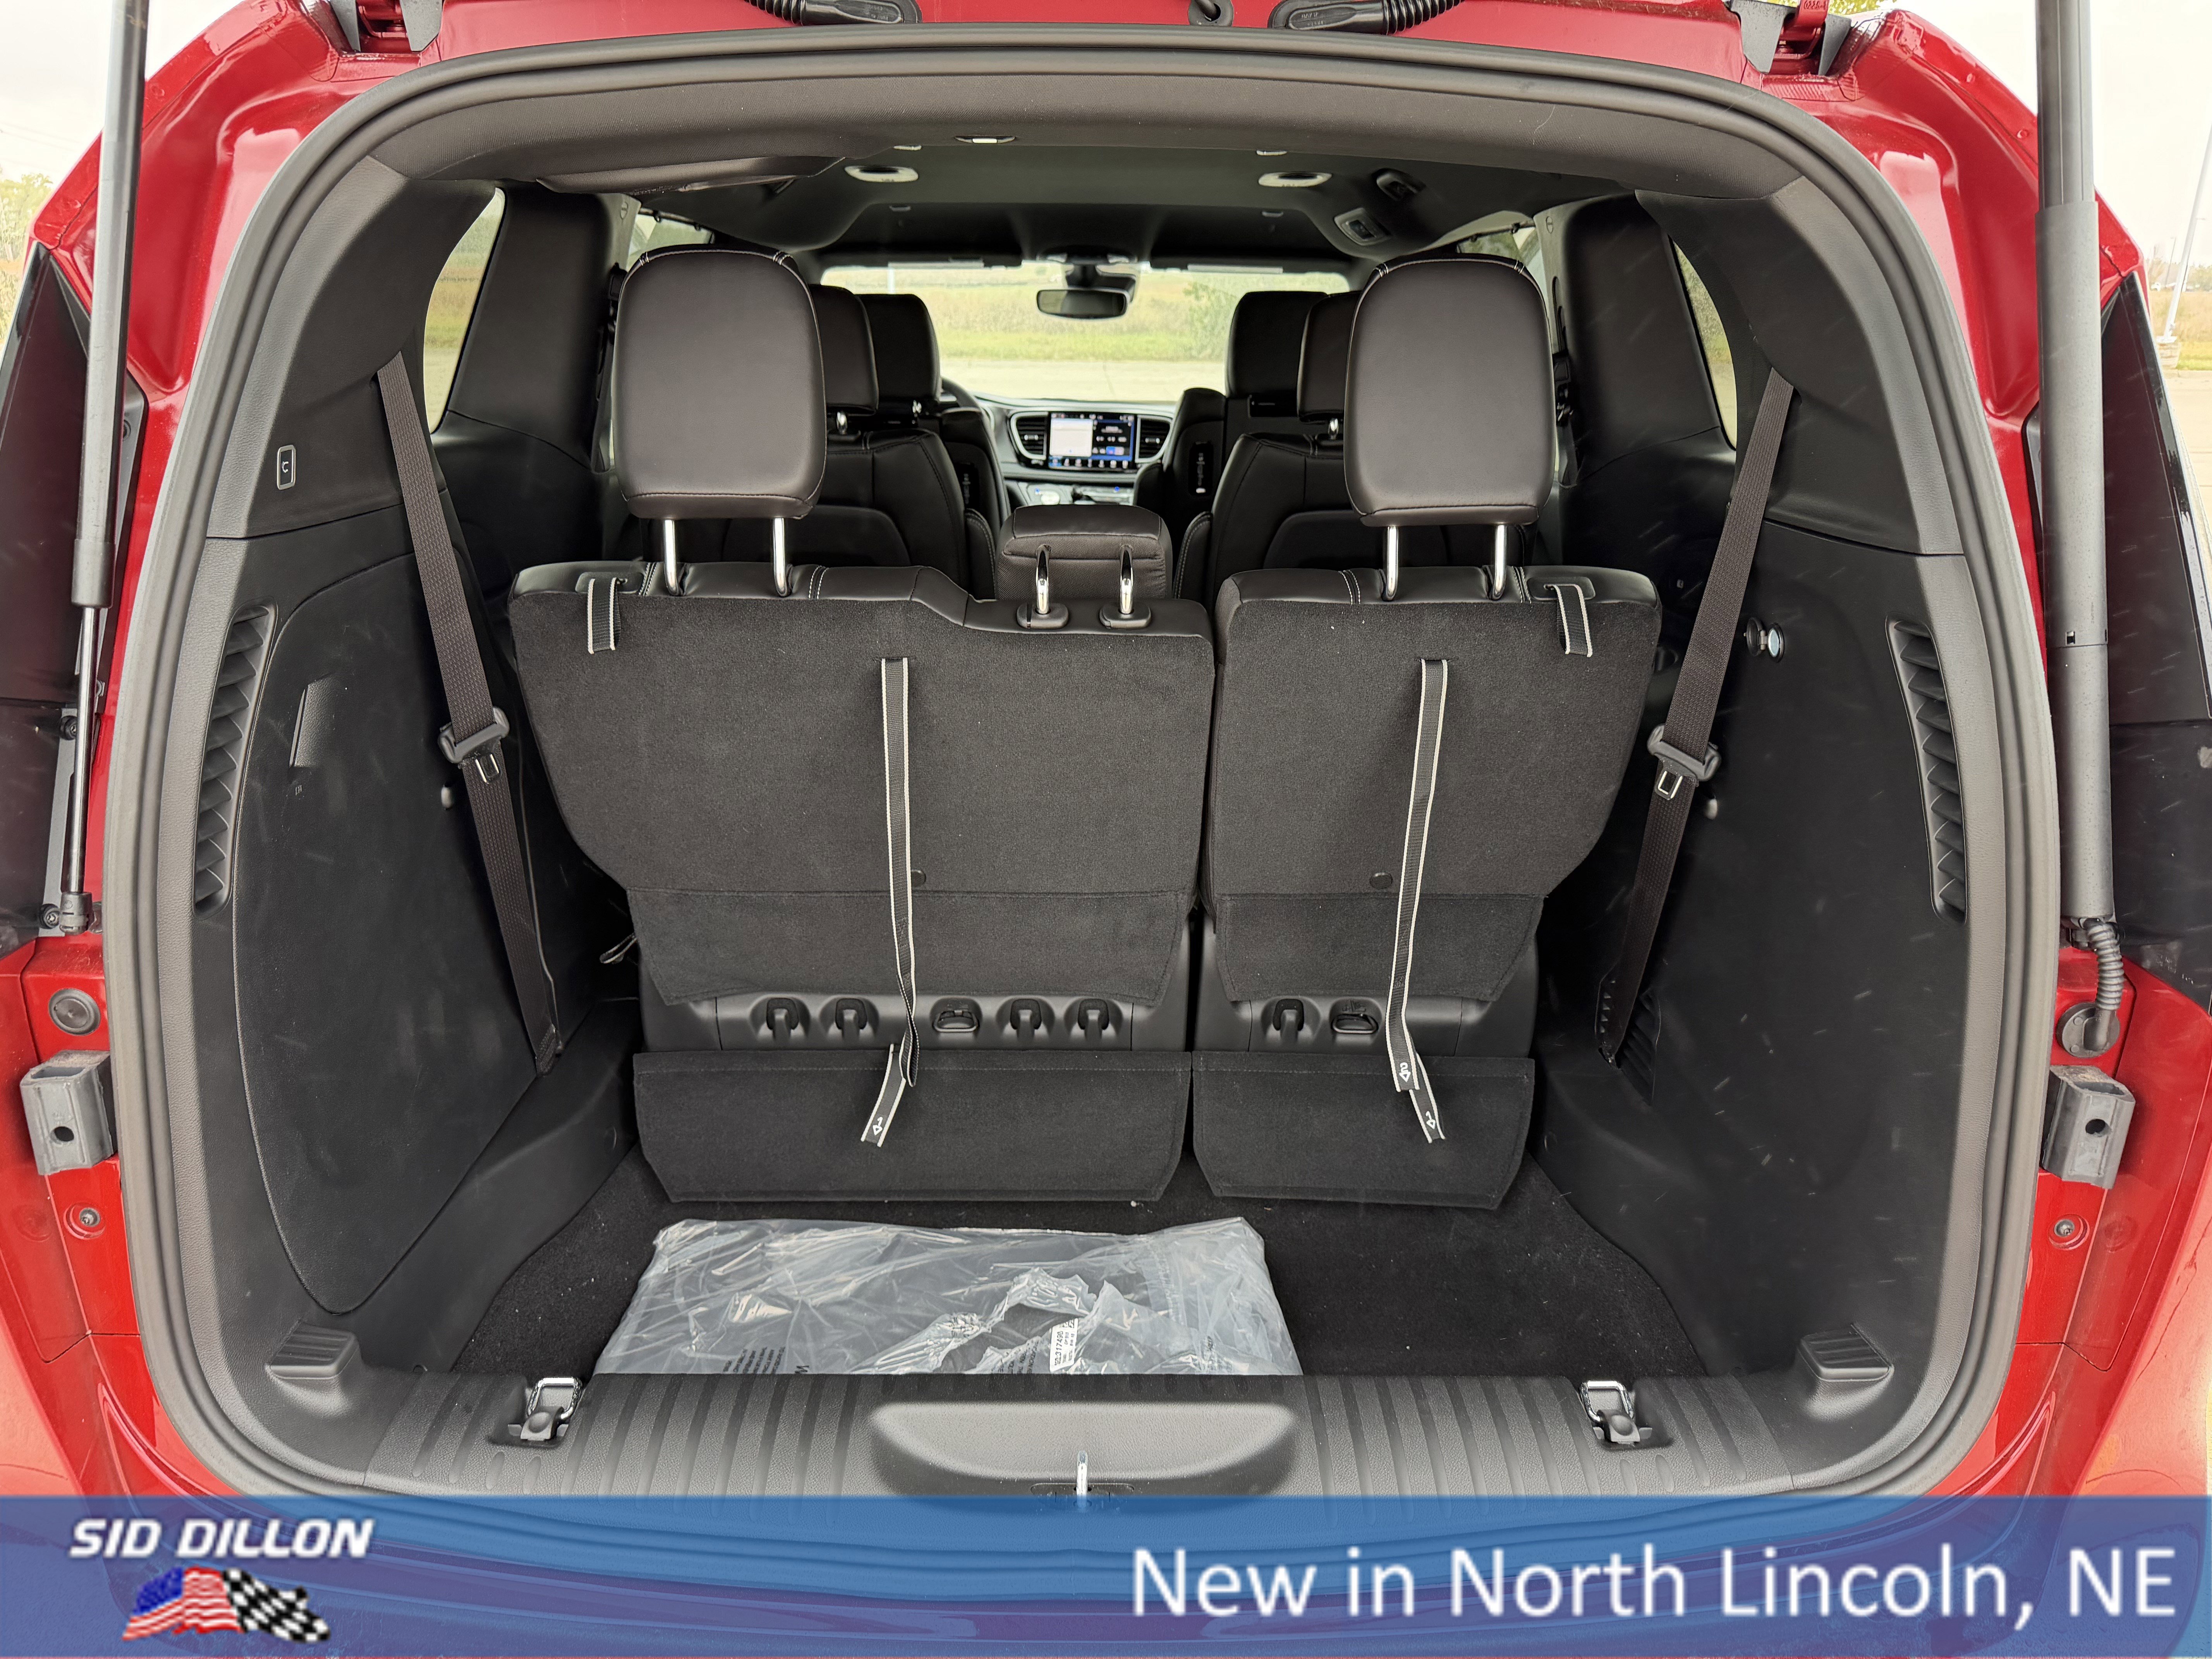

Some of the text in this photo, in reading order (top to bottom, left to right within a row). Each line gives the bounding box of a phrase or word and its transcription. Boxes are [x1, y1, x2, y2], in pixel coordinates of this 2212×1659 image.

[1400, 1062, 1408, 1072] 2
[1425, 1111, 1432, 1120] 1
[877, 1116, 883, 1126] 1
